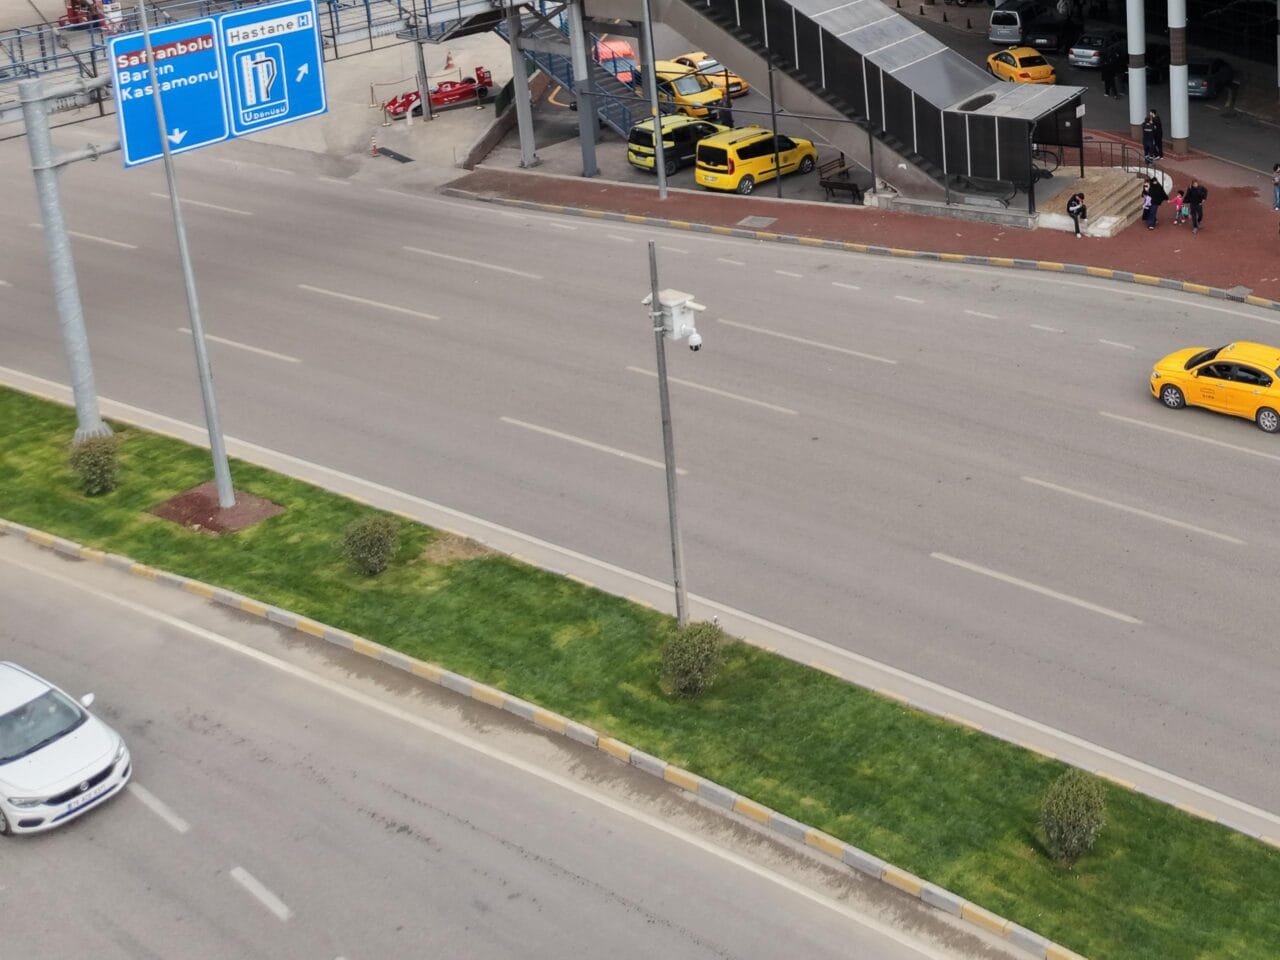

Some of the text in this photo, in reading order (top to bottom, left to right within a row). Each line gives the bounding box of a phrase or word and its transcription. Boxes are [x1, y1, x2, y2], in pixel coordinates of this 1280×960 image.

[230, 20, 294, 43] Hastane
[119, 63, 175, 85] Barın
[121, 69, 219, 101] Kasamonu
